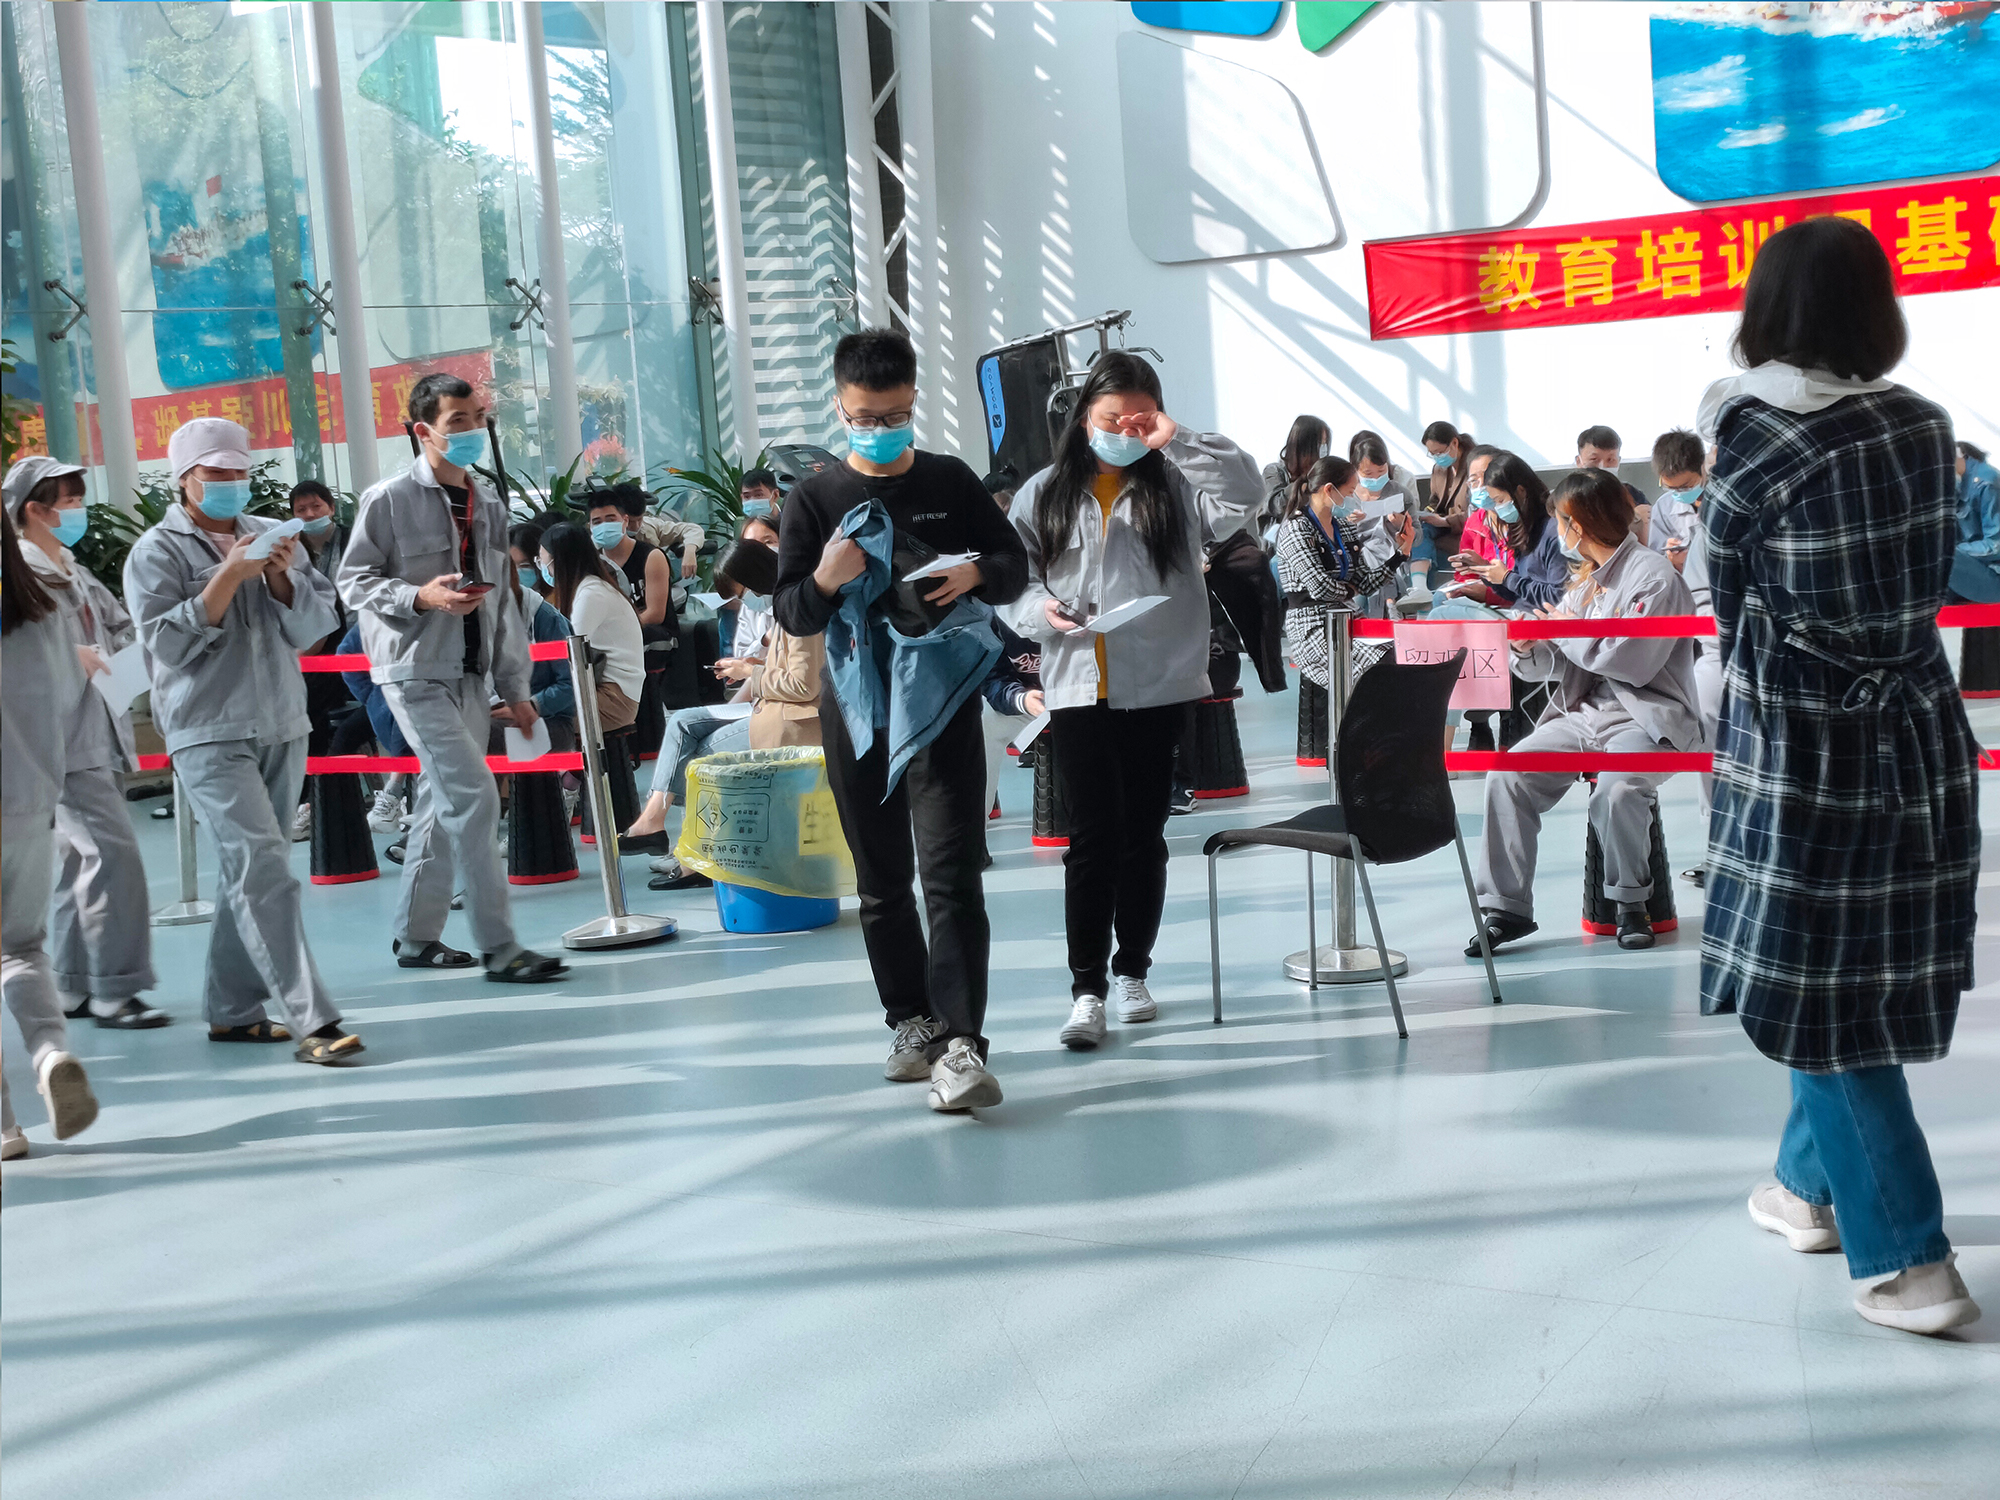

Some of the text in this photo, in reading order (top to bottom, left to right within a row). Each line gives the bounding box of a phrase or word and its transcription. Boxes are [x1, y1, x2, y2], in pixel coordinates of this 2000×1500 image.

[1478, 195, 2000, 314] 教育培训基
